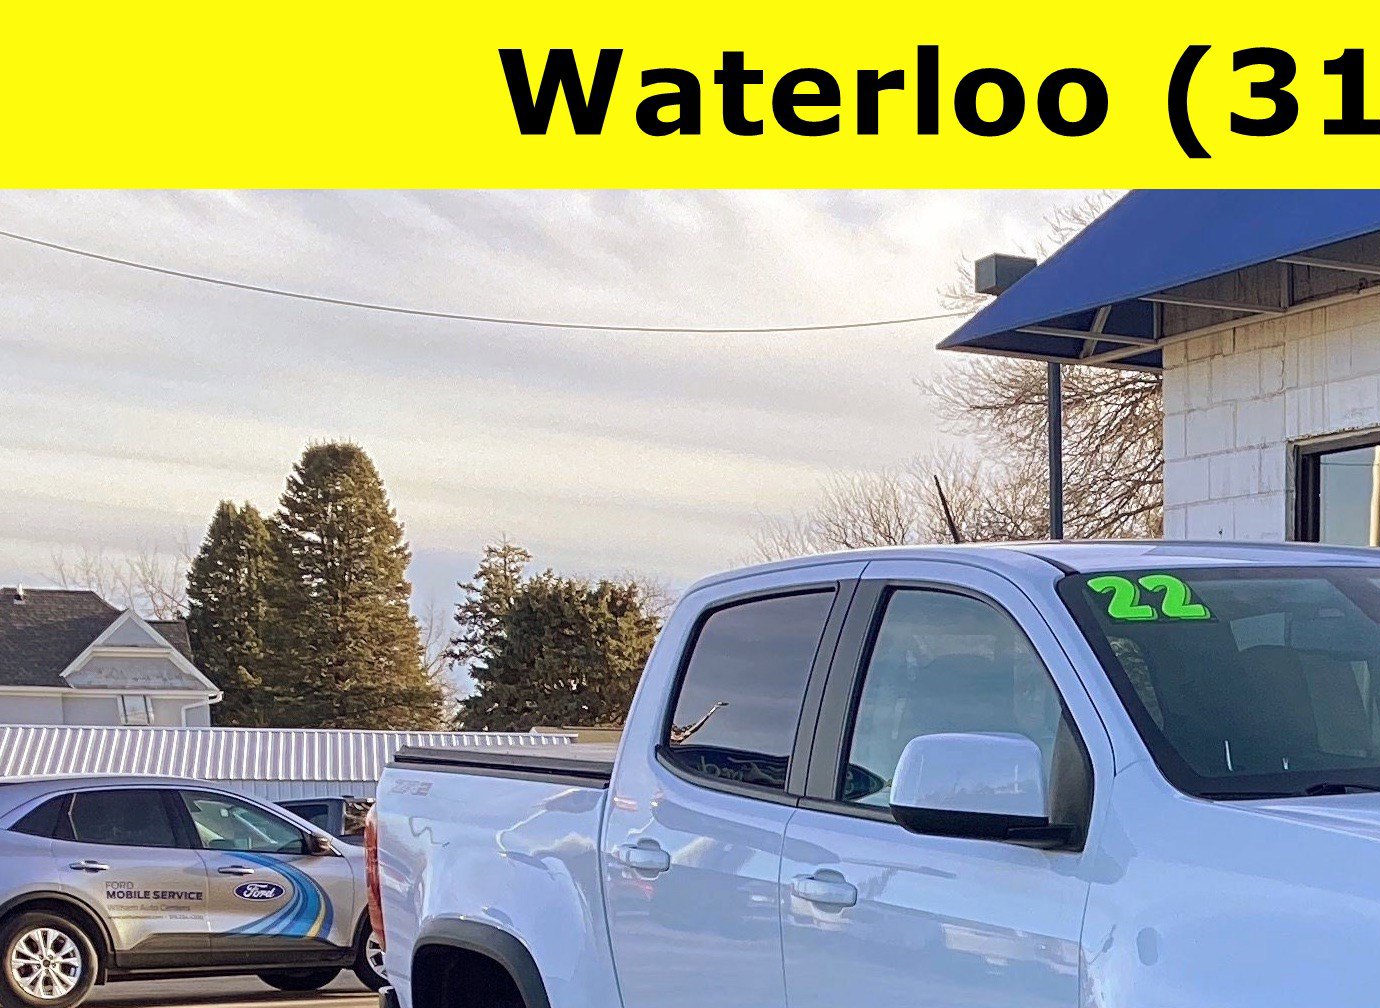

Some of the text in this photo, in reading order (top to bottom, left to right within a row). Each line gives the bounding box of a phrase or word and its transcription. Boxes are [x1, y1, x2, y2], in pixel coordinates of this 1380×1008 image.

[1086, 574, 1211, 620] 22
[105, 881, 134, 890] FORD
[241, 884, 276, 900] Ford
[106, 890, 203, 901] MOBILE SERVICE
